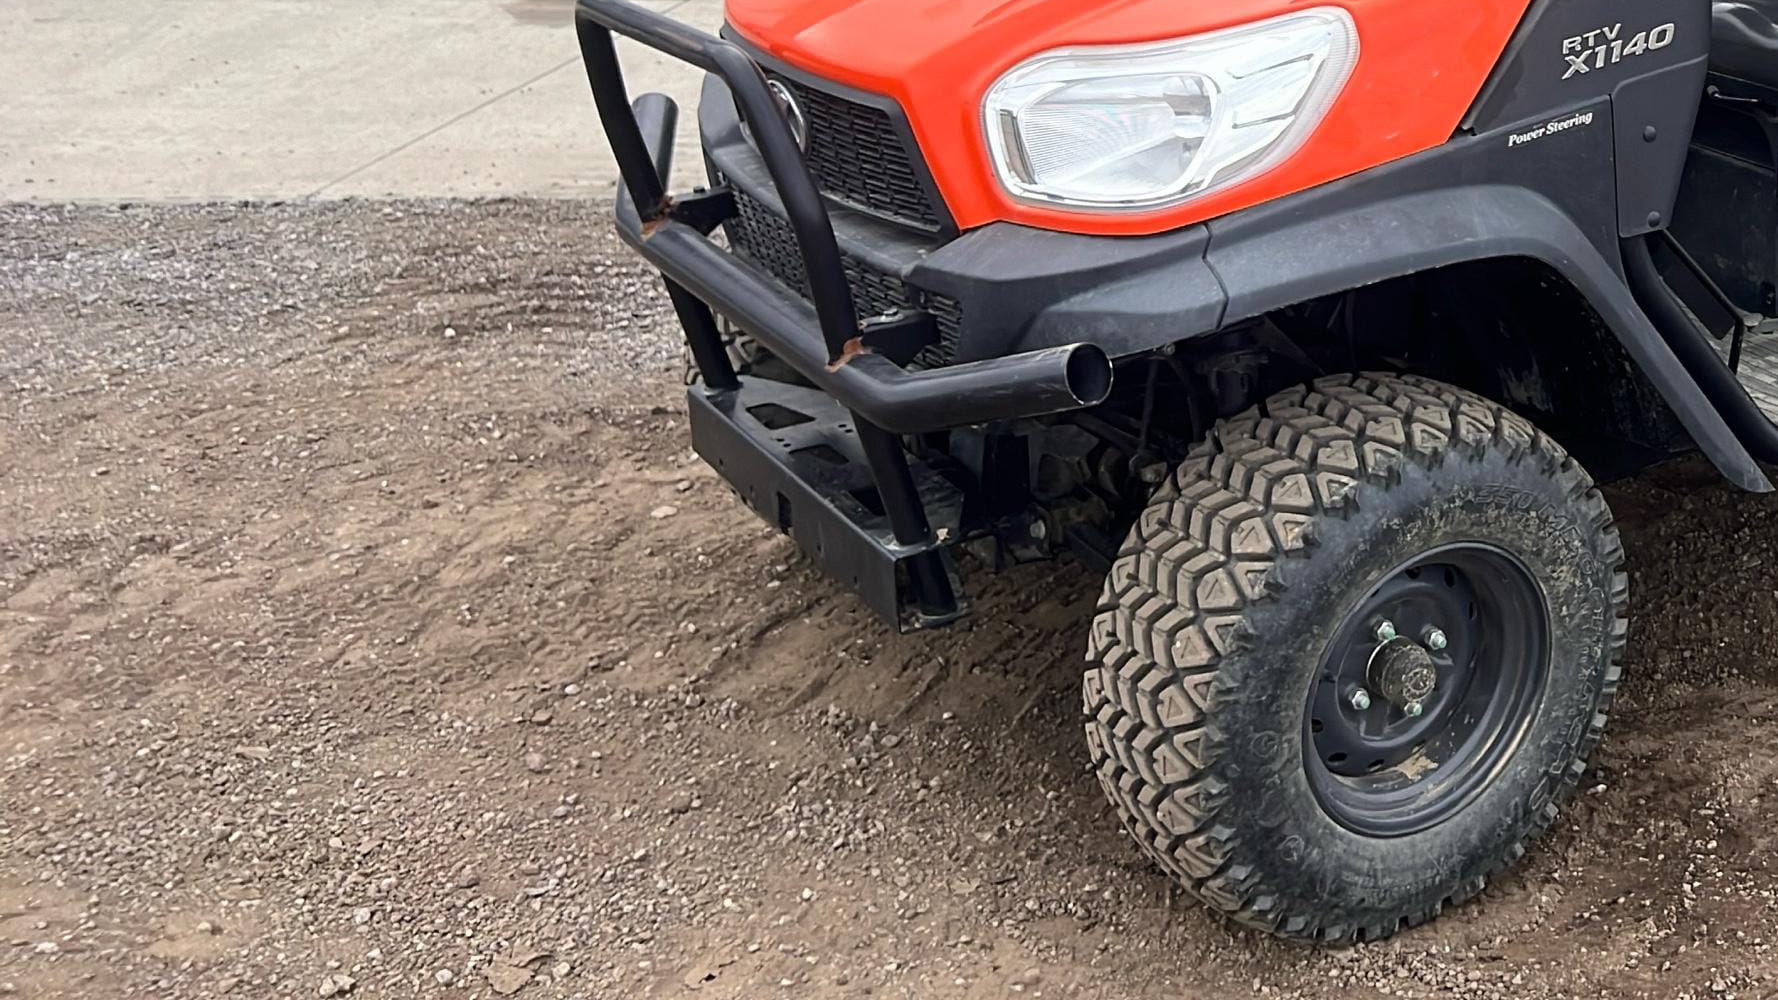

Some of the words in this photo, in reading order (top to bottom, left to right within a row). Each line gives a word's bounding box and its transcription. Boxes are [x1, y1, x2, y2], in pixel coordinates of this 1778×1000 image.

[1561, 23, 1675, 80] X1140
[1562, 23, 1622, 54] RTV
[1508, 126, 1546, 147] Power
[1546, 111, 1593, 136] Steering
